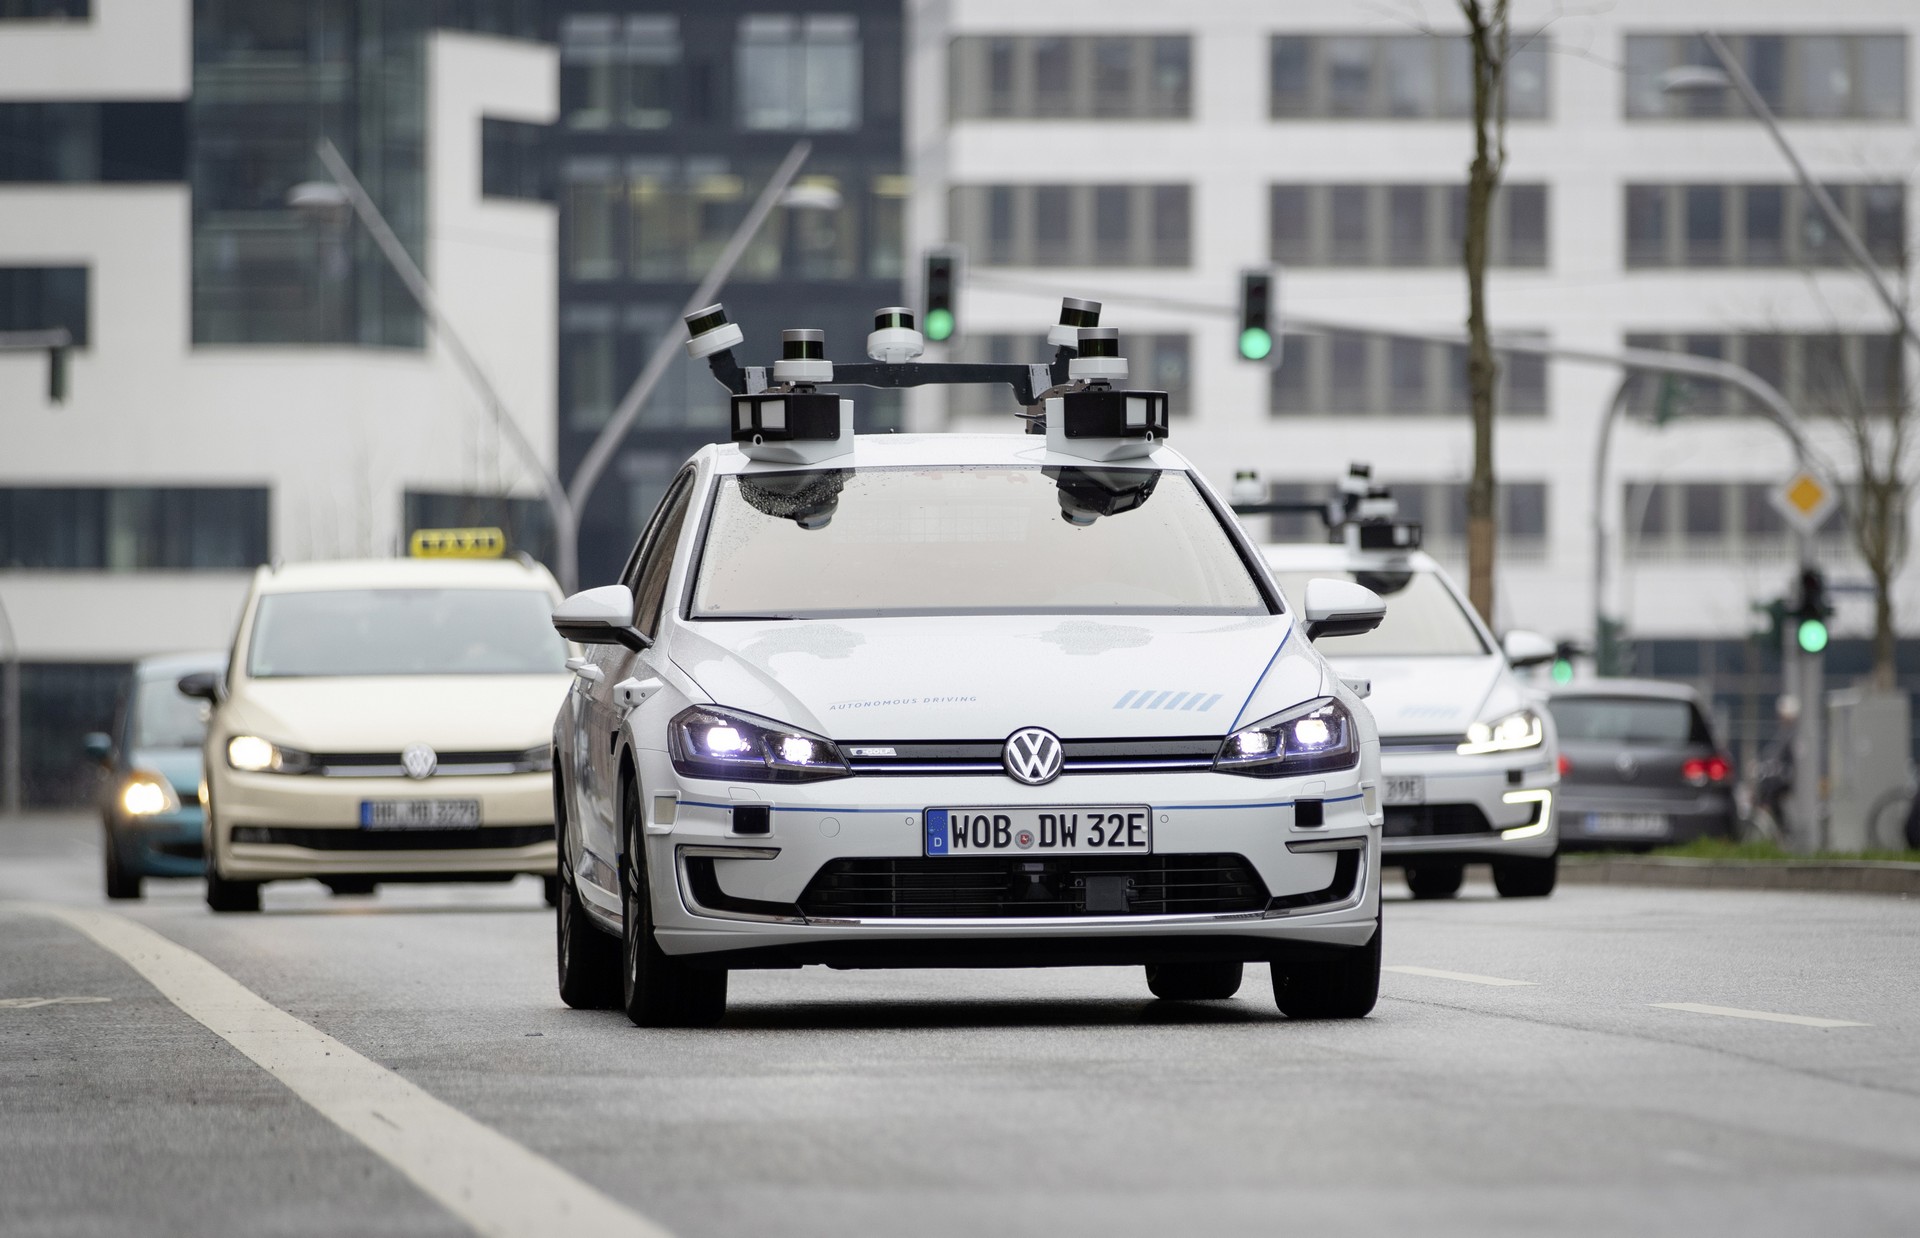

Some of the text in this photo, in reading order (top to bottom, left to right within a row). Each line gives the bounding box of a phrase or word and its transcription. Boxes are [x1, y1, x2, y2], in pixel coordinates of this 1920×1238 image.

[829, 696, 977, 711] AUTONOMOUS DRIVING
[951, 813, 1146, 848] WOB DW 32E
[933, 837, 943, 848] D
